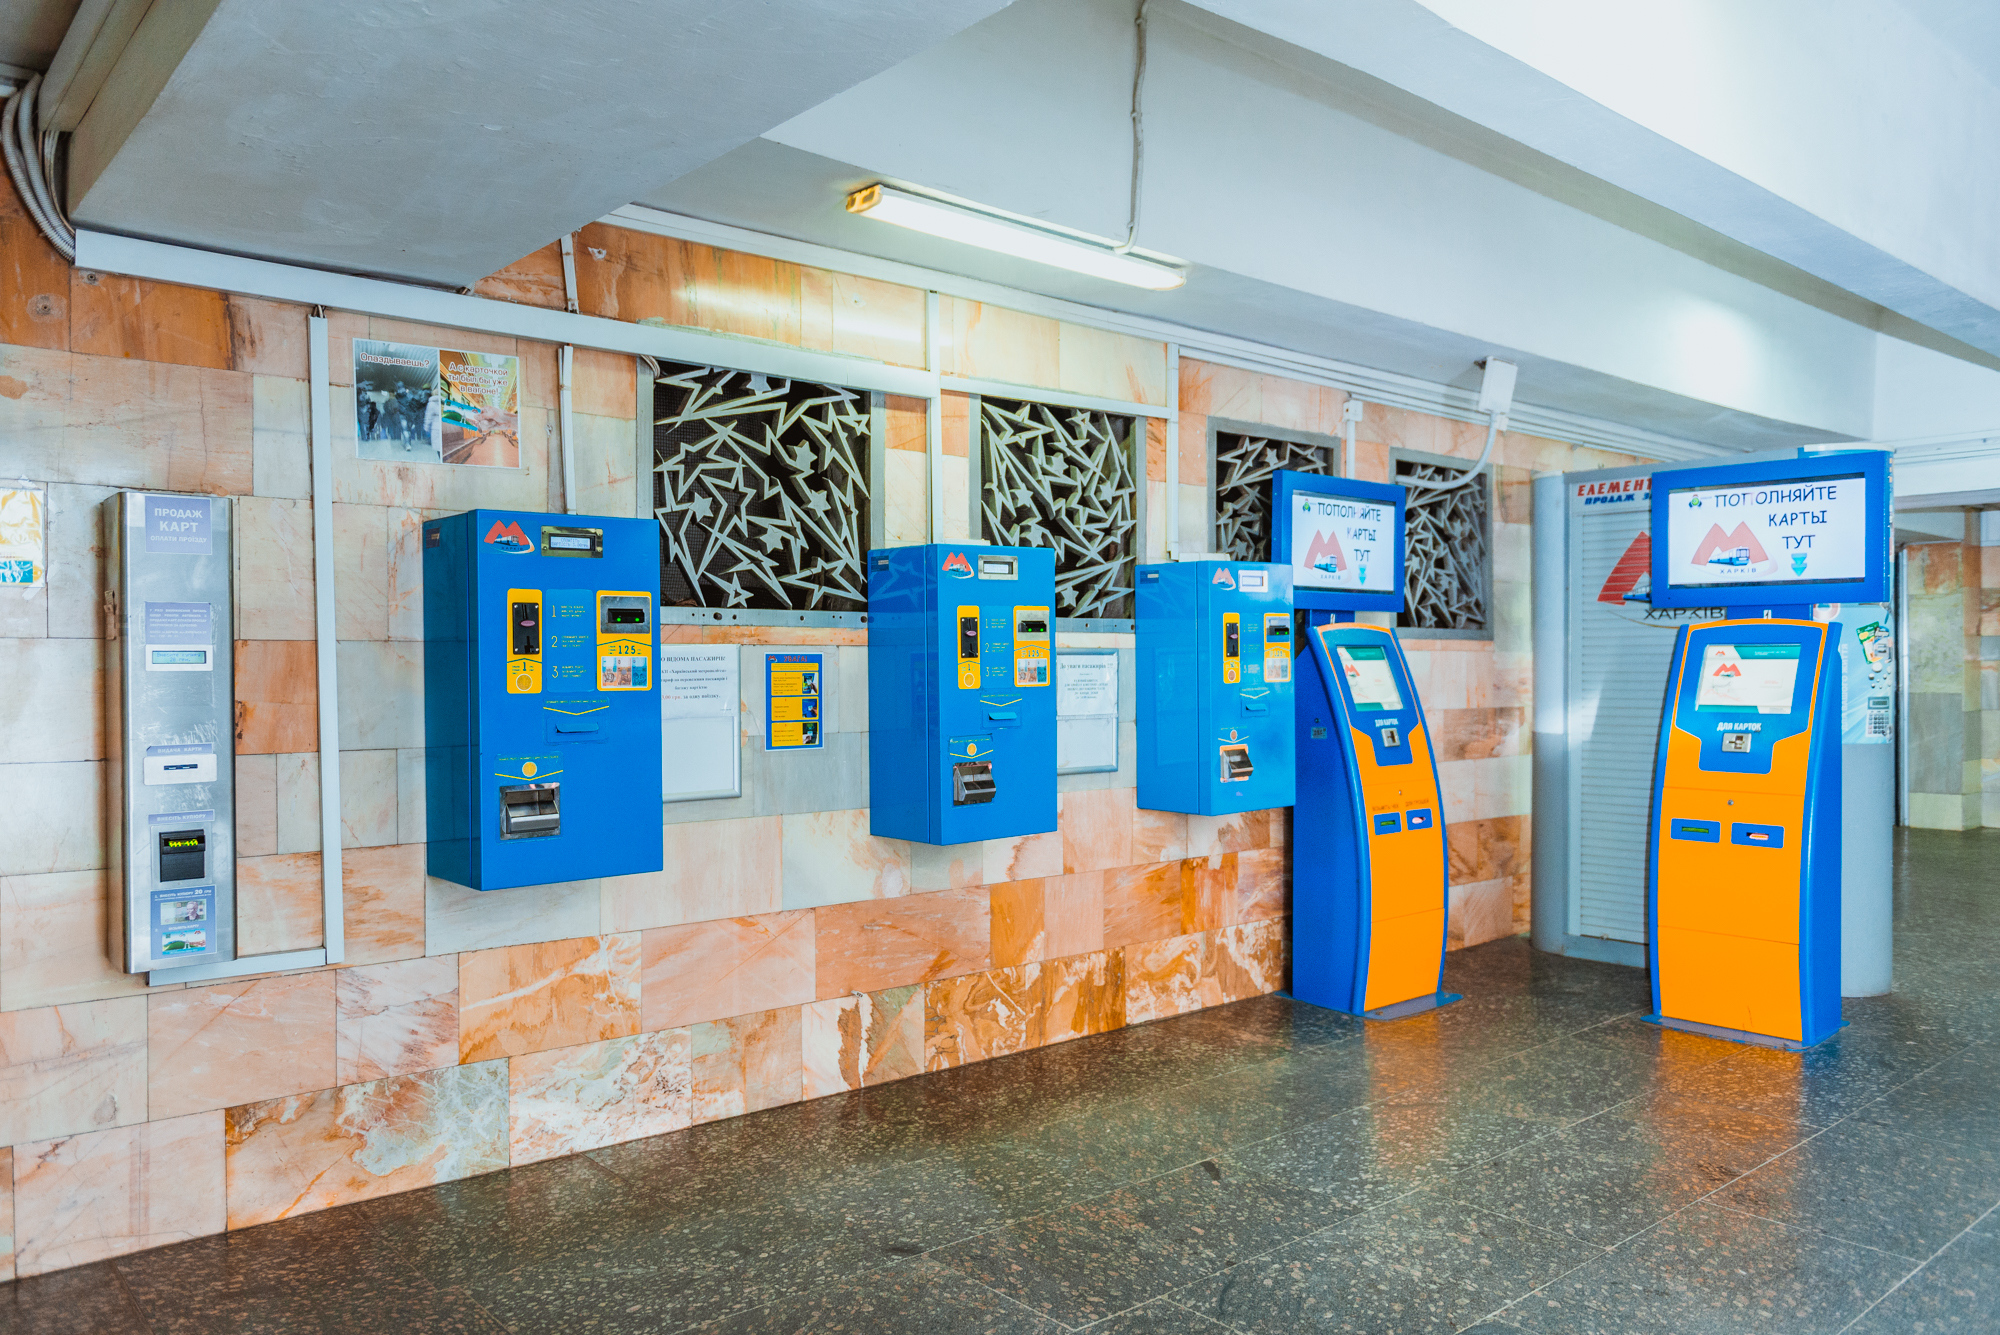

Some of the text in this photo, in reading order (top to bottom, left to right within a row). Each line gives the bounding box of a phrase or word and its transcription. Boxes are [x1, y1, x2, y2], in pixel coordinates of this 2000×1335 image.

[360, 352, 430, 368] Опаздываешь?
[449, 362, 457, 371] А
[465, 365, 508, 376] карточкой
[448, 374, 508, 387] ты был бы уже
[468, 386, 499, 395] вагоне!
[1584, 493, 1635, 505] ПРОДАЖ
[1715, 484, 1837, 508] ПОПОЛНЯЙТЕ
[155, 508, 203, 519] ПРОДАЖ
[1318, 502, 1381, 521] ПОПОЛНЯЙТЕ
[1768, 510, 1828, 527] КАРТЫ
[160, 521, 198, 533] КАРТ
[1347, 527, 1376, 541] КАРТЫ
[1781, 535, 1815, 549] ТУТ
[1354, 549, 1371, 562] ТУТ
[1720, 567, 1757, 575] ХАРКІВ
[552, 605, 556, 617] 1
[551, 635, 558, 648] 2
[551, 666, 559, 678] 3
[1717, 722, 1762, 731] ДЛЯ КАРТОК
